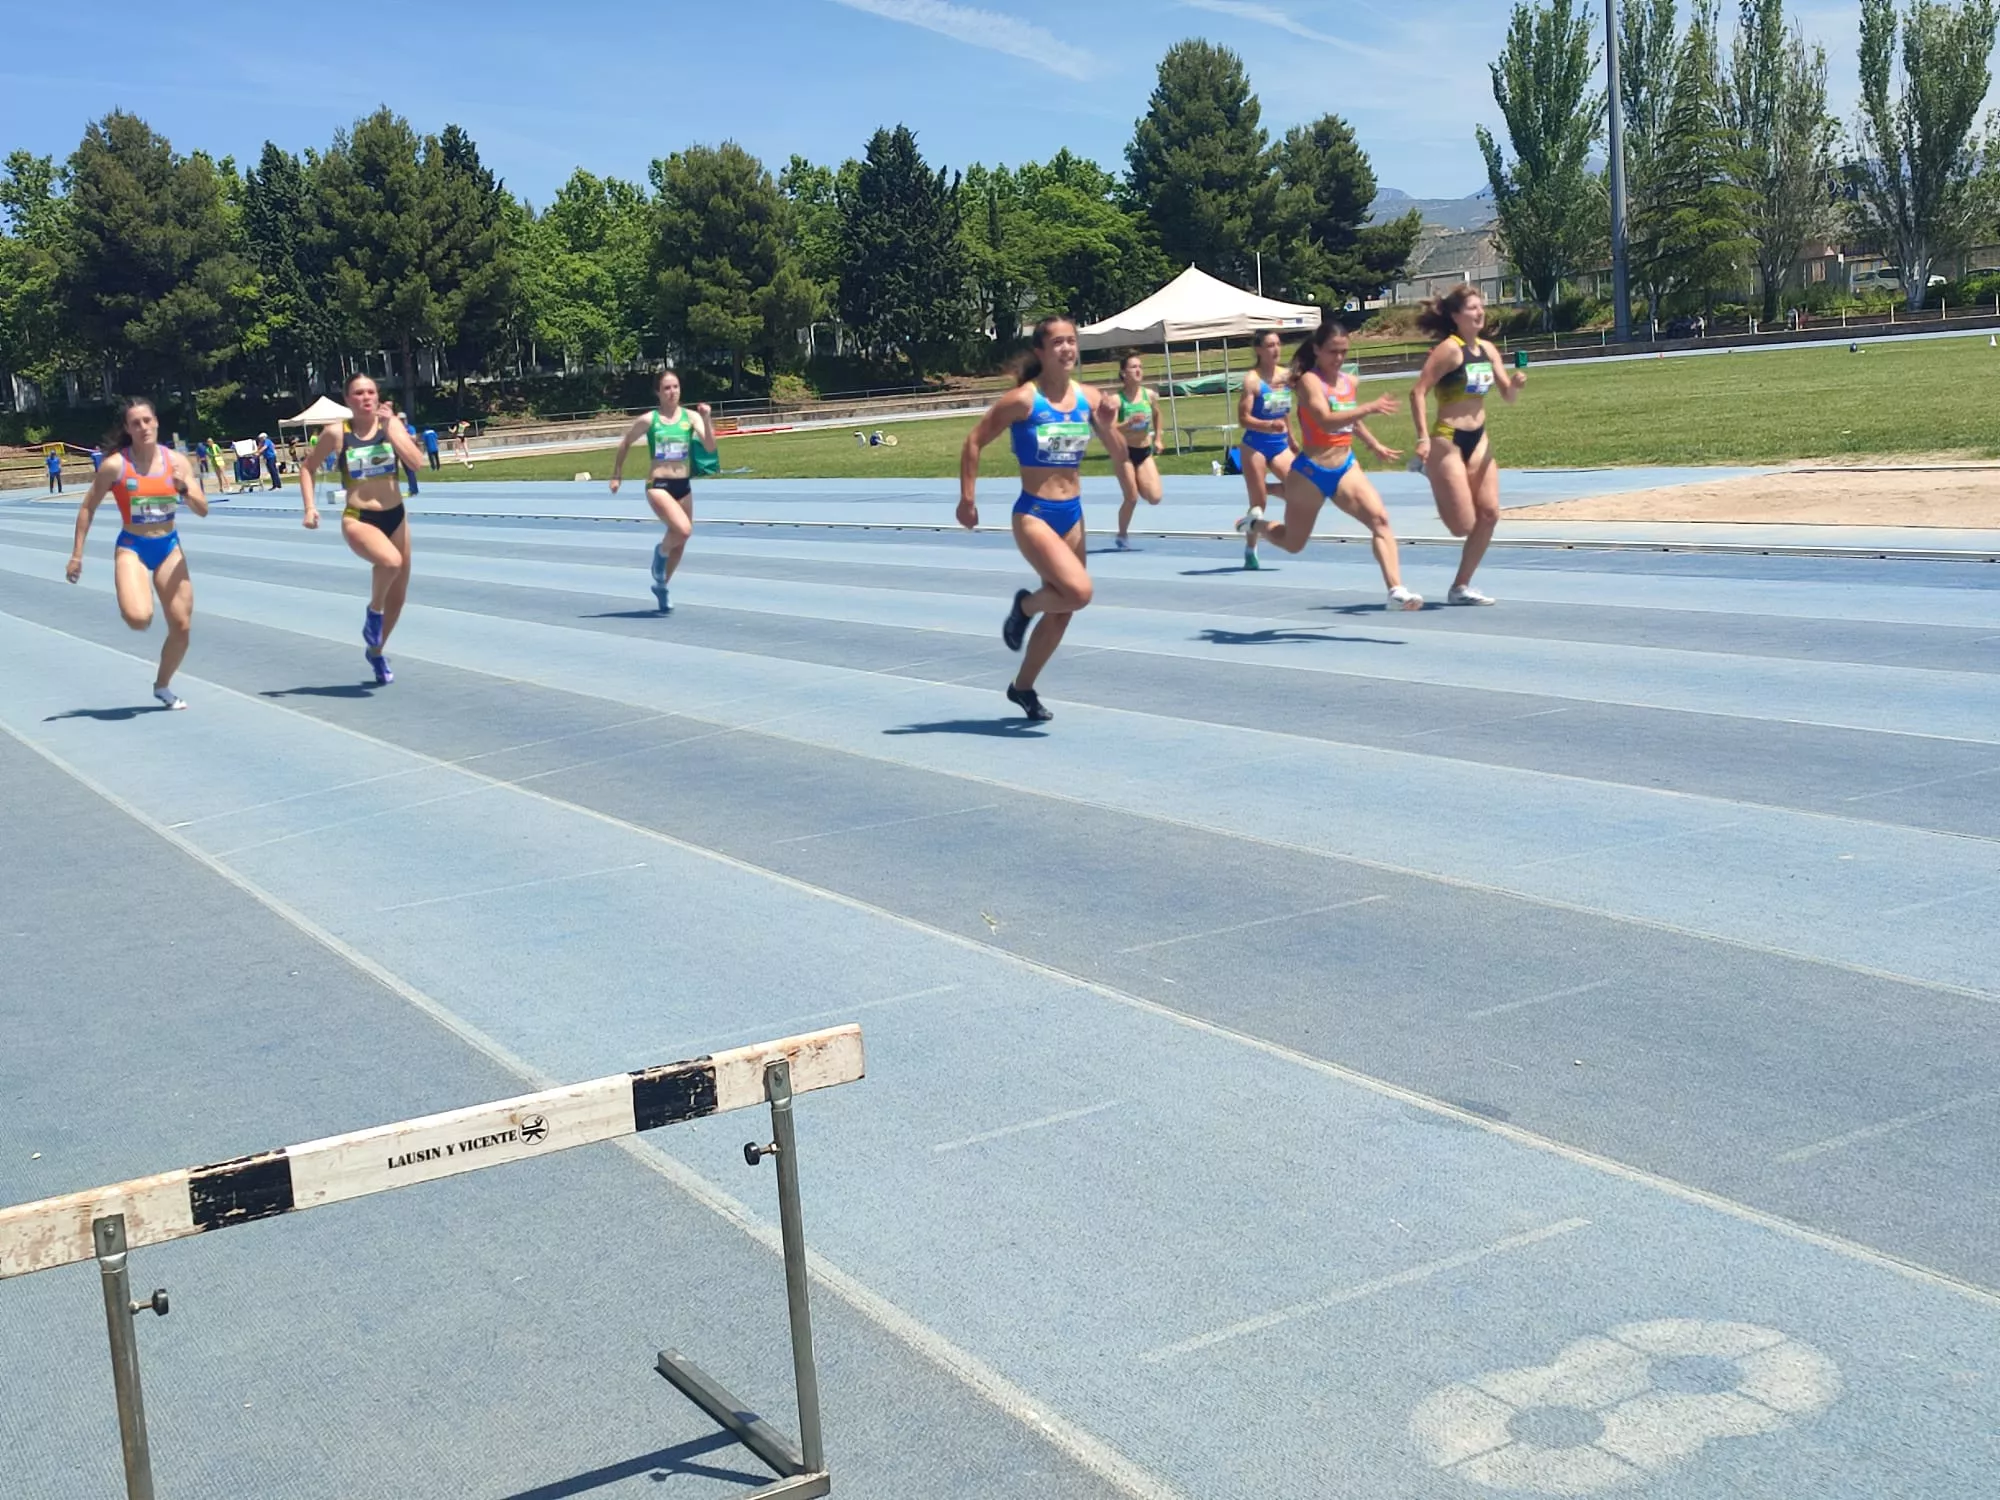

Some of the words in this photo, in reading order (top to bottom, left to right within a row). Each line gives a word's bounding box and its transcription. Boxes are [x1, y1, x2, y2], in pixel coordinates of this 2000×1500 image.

[388, 1147, 441, 1169] LAUSIN
[445, 1144, 455, 1156] Y
[458, 1130, 518, 1152] VICENTE
[1410, 1318, 1842, 1495] 8
